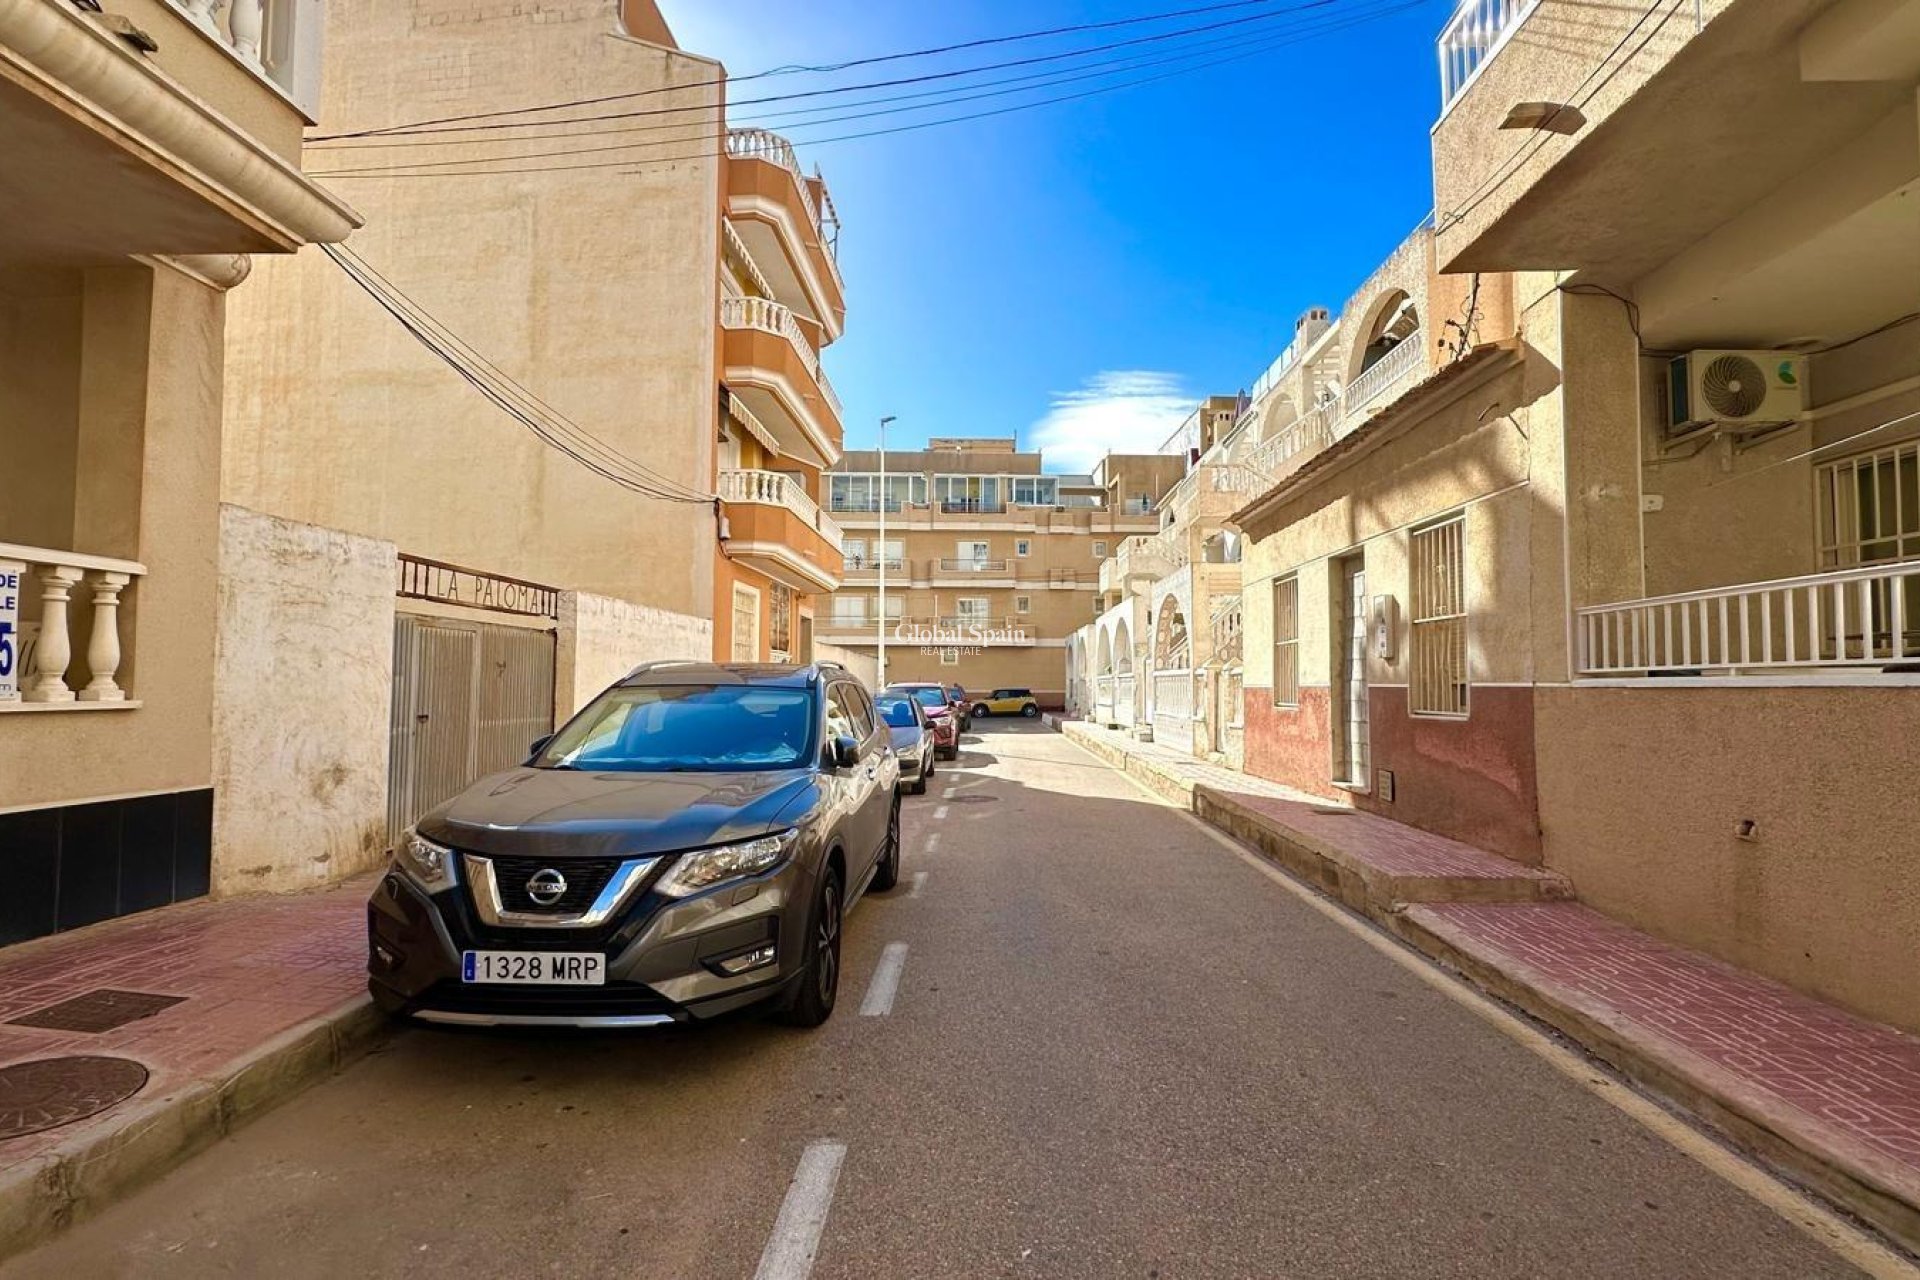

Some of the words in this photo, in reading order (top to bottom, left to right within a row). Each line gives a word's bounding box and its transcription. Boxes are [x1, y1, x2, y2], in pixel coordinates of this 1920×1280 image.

[437, 567, 458, 600] LA
[475, 576, 538, 613] PALOMA
[483, 955, 542, 979] 1328
[552, 956, 598, 980] MRP
